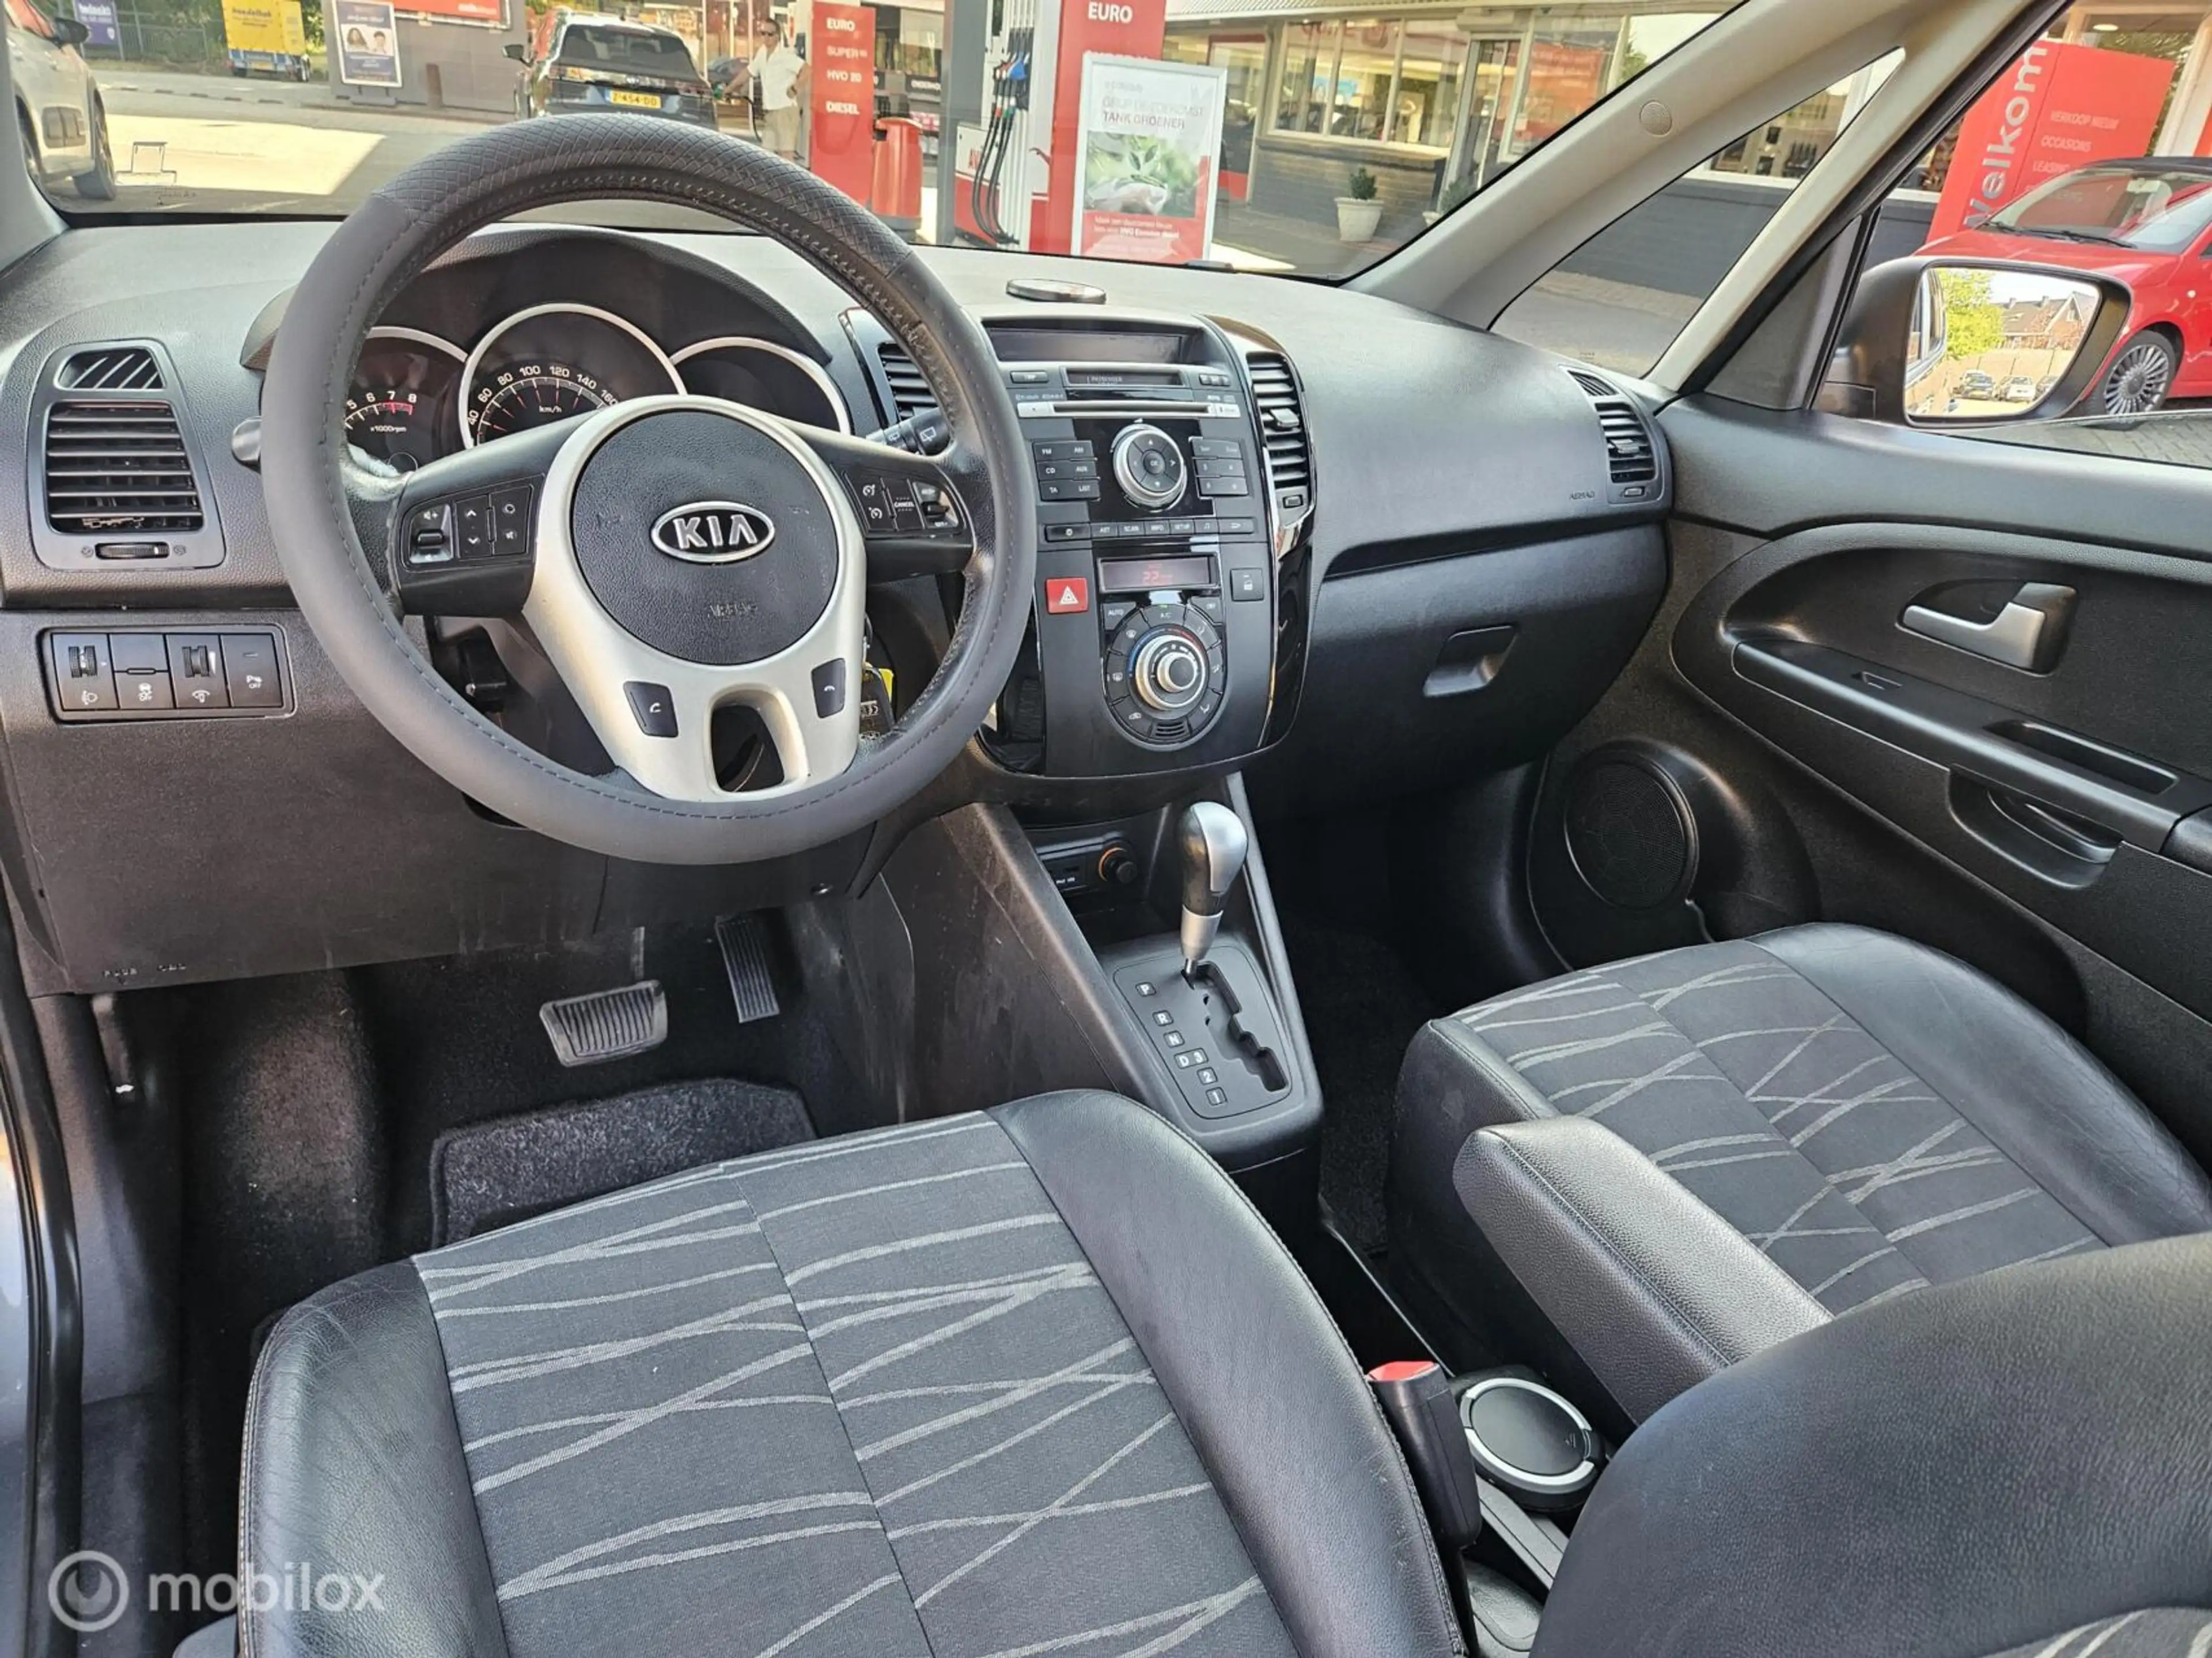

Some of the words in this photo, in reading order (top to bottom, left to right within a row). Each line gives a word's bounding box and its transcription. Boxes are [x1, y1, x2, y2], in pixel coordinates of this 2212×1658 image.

[1088, 2, 1133, 24] EURO
[827, 17, 855, 32] EURO
[827, 45, 858, 59] SUPER
[827, 69, 849, 81] HVO
[825, 100, 860, 115] DIESEL
[1103, 110, 1131, 124] TANK
[520, 365, 541, 375] 100
[550, 366, 570, 378] 120
[497, 373, 513, 385] 80
[577, 374, 597, 389] 140
[365, 392, 376, 403] 6
[387, 390, 396, 400] 7
[408, 393, 417, 403] 8
[478, 388, 493, 403] 60
[601, 389, 619, 406] 160
[347, 400, 357, 409] 5
[539, 405, 562, 413] km/h
[467, 409, 479, 425] 40
[672, 514, 758, 550] KIA
[1140, 984, 1150, 995] P
[1157, 1012, 1168, 1023] R
[1168, 1034, 1180, 1045] N
[1179, 1056, 1190, 1067] D
[1193, 1051, 1203, 1063] 3
[1202, 1071, 1213, 1083] 2
[1212, 1091, 1220, 1103] 1
